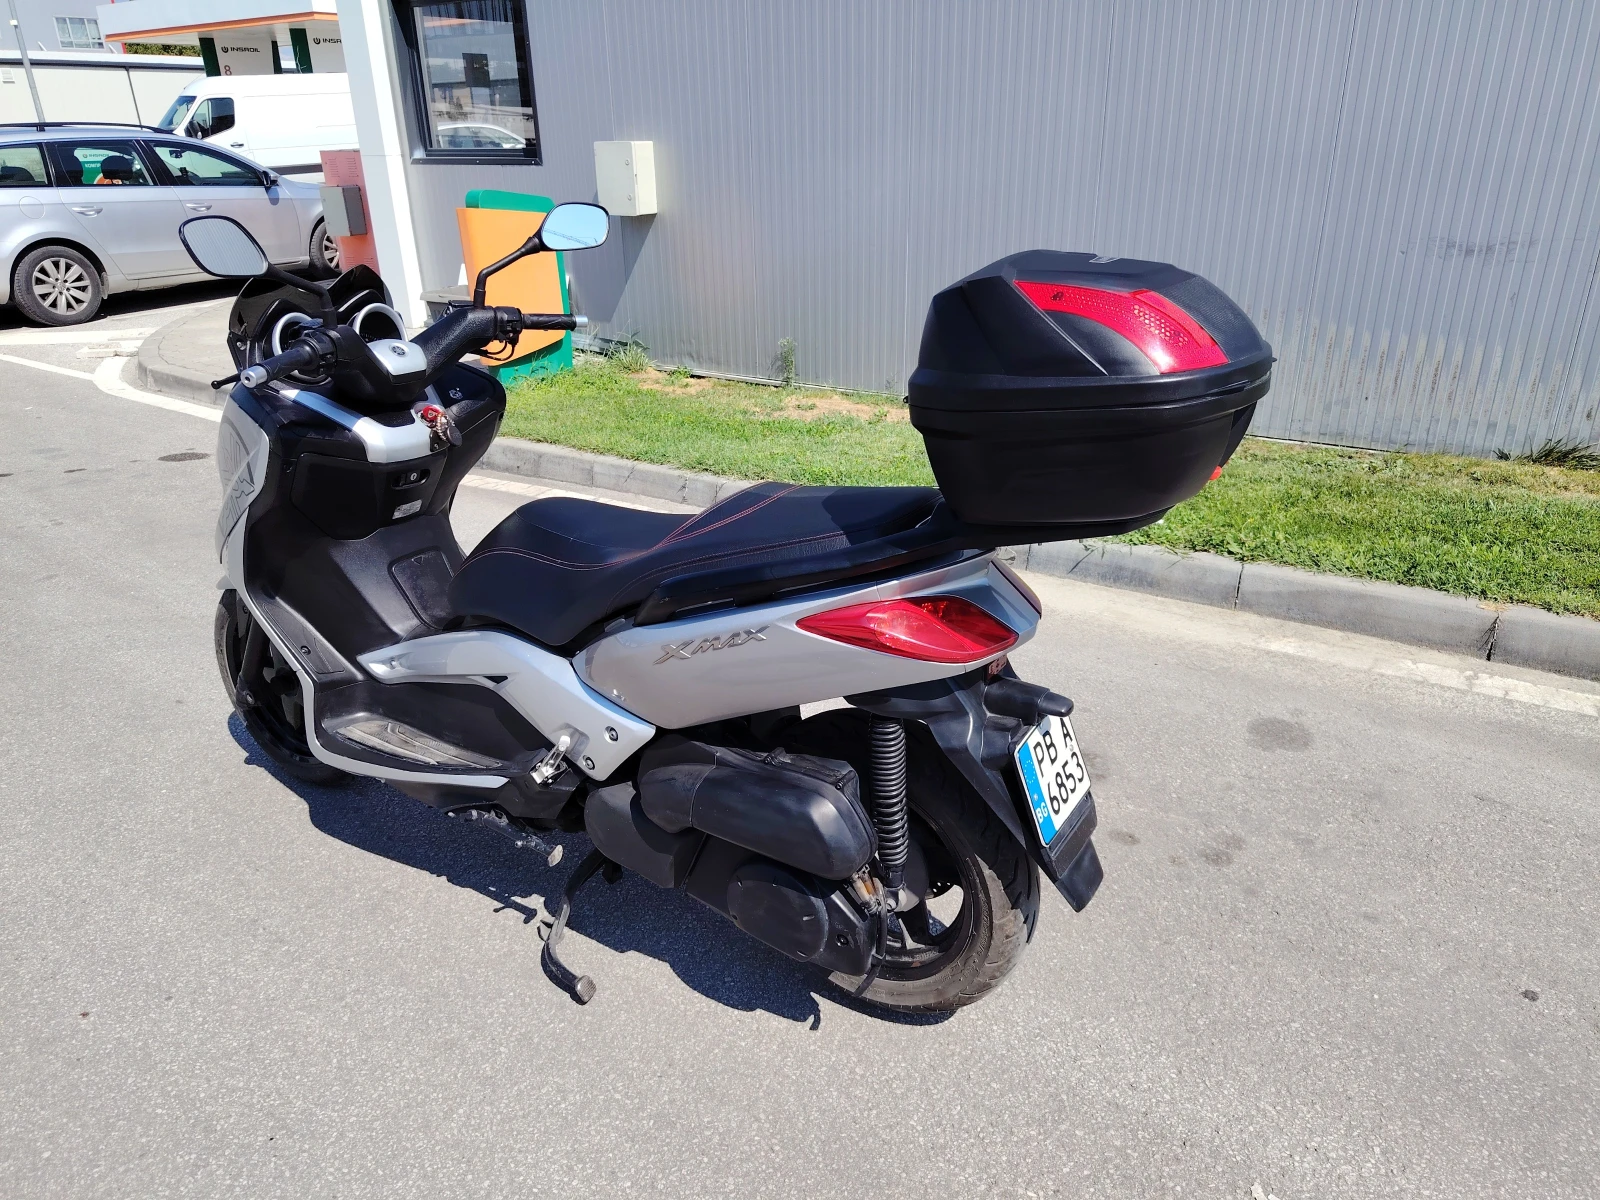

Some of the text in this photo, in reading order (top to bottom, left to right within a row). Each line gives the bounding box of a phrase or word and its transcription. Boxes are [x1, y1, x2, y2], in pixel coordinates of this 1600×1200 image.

[224, 65, 232, 76] 8
[1033, 717, 1073, 778] PB A
[1047, 751, 1085, 815] 6853
[1035, 802, 1049, 824] BG
